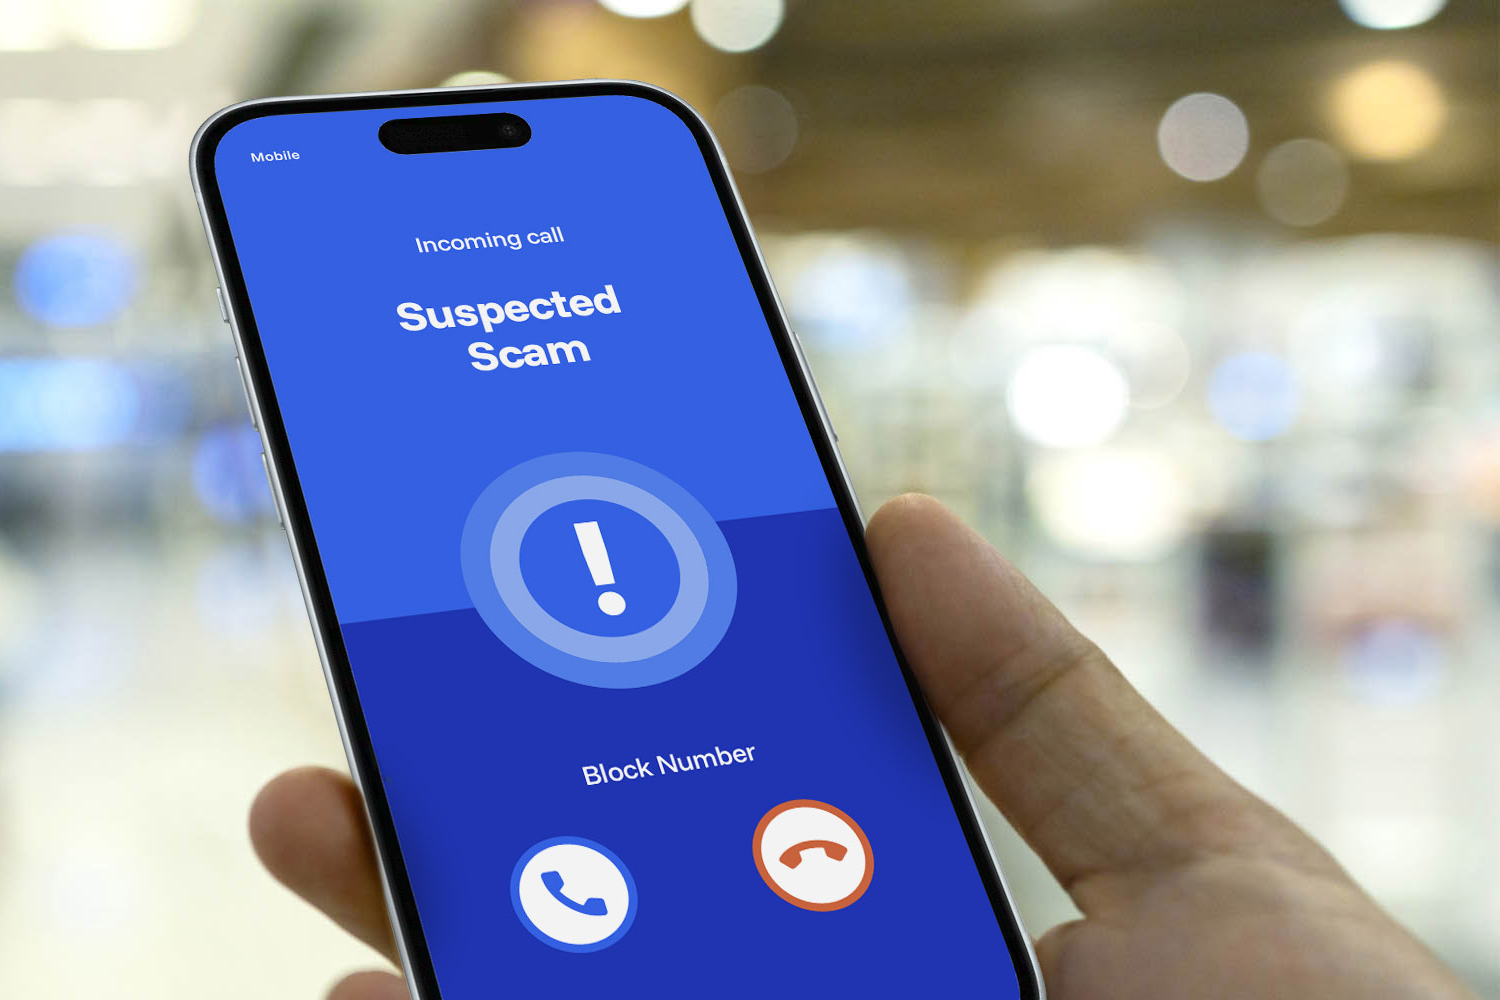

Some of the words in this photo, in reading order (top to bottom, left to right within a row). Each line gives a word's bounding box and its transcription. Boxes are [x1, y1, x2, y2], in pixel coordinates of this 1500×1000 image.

[250, 150, 301, 163] Mobile
[415, 232, 522, 253] Incoming
[526, 226, 565, 245] call
[396, 284, 622, 333] Suspected
[467, 340, 592, 372] Scam
[582, 757, 654, 786] Block
[656, 746, 756, 775] Number
